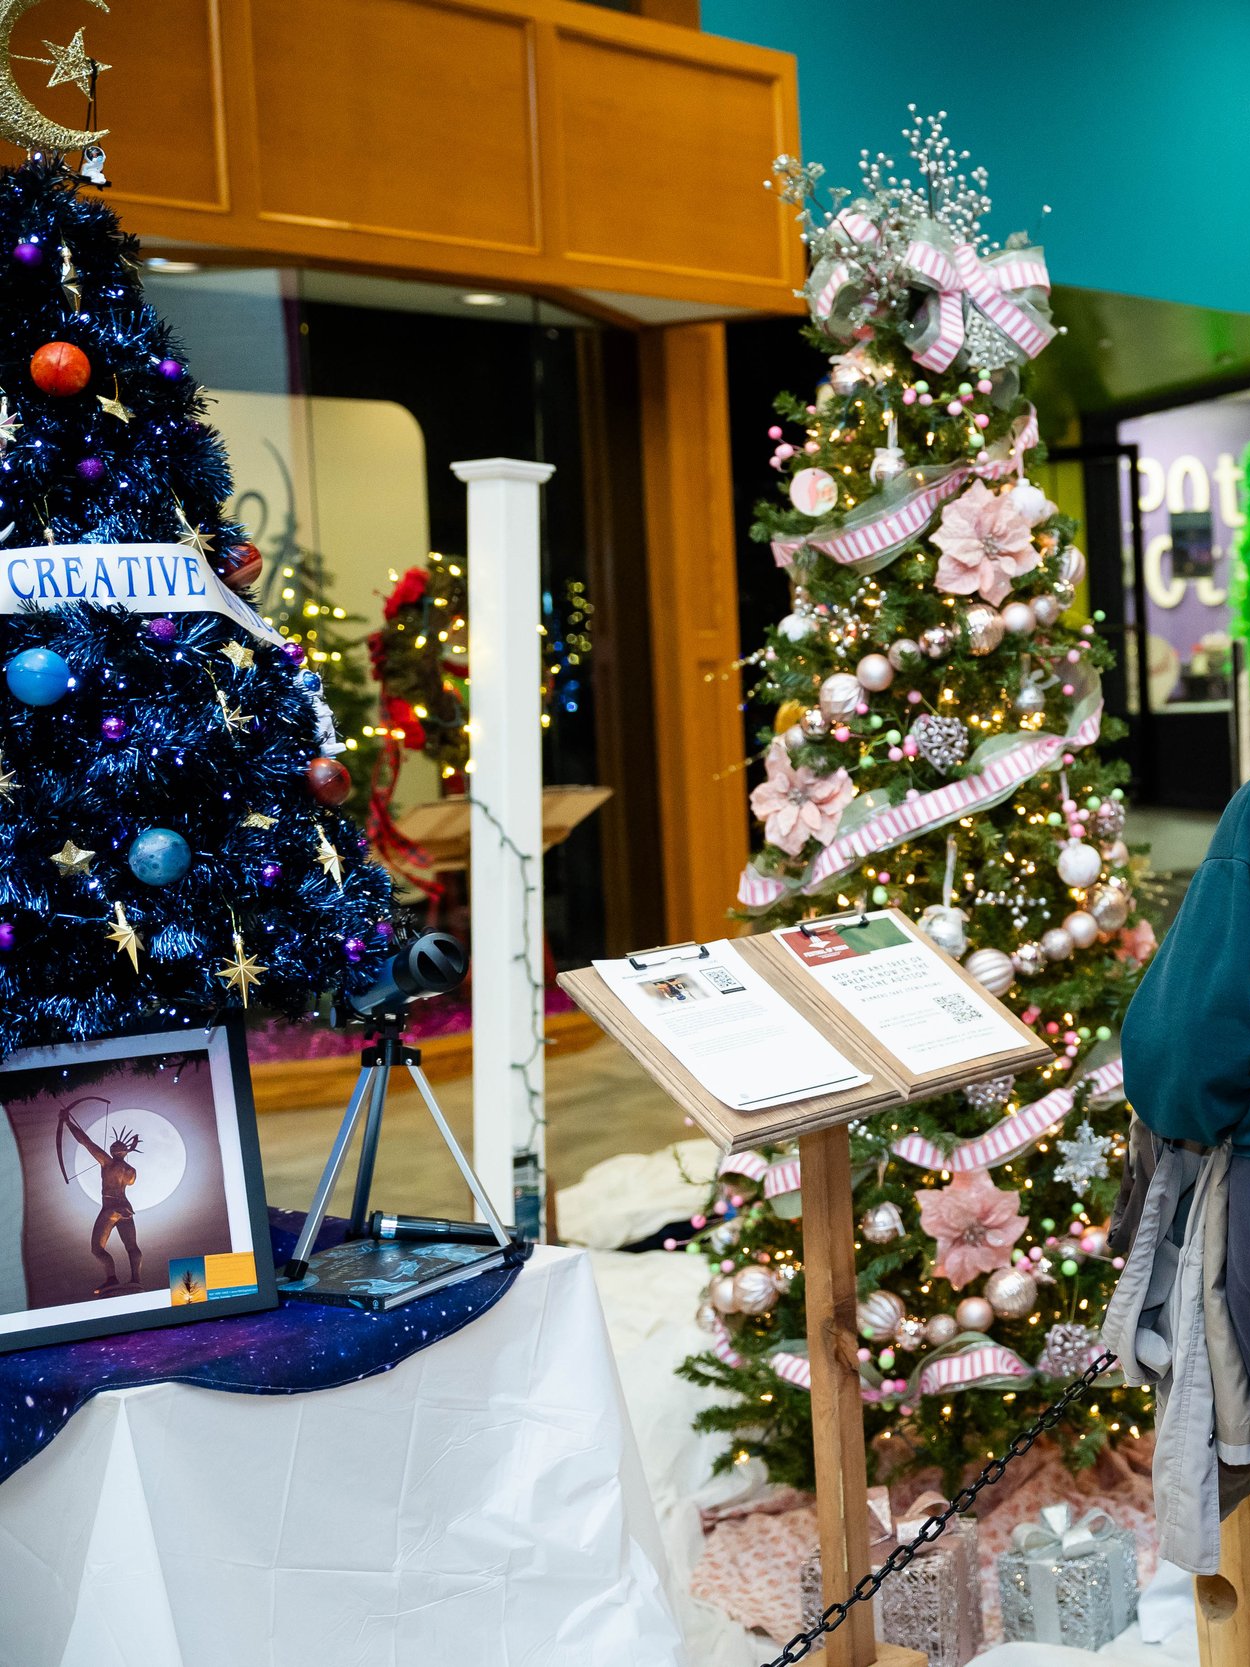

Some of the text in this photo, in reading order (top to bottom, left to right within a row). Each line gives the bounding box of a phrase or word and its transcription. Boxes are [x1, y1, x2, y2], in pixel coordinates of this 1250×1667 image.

[7, 556, 206, 600] CREATIVE
[832, 973, 849, 981] BID
[851, 968, 865, 976] ON
[868, 964, 884, 972] ANY
[887, 959, 907, 968] TREE
[839, 973, 874, 987] WREATH
[878, 970, 899, 978] NOW
[854, 971, 928, 992] ONLINE AUCTION
